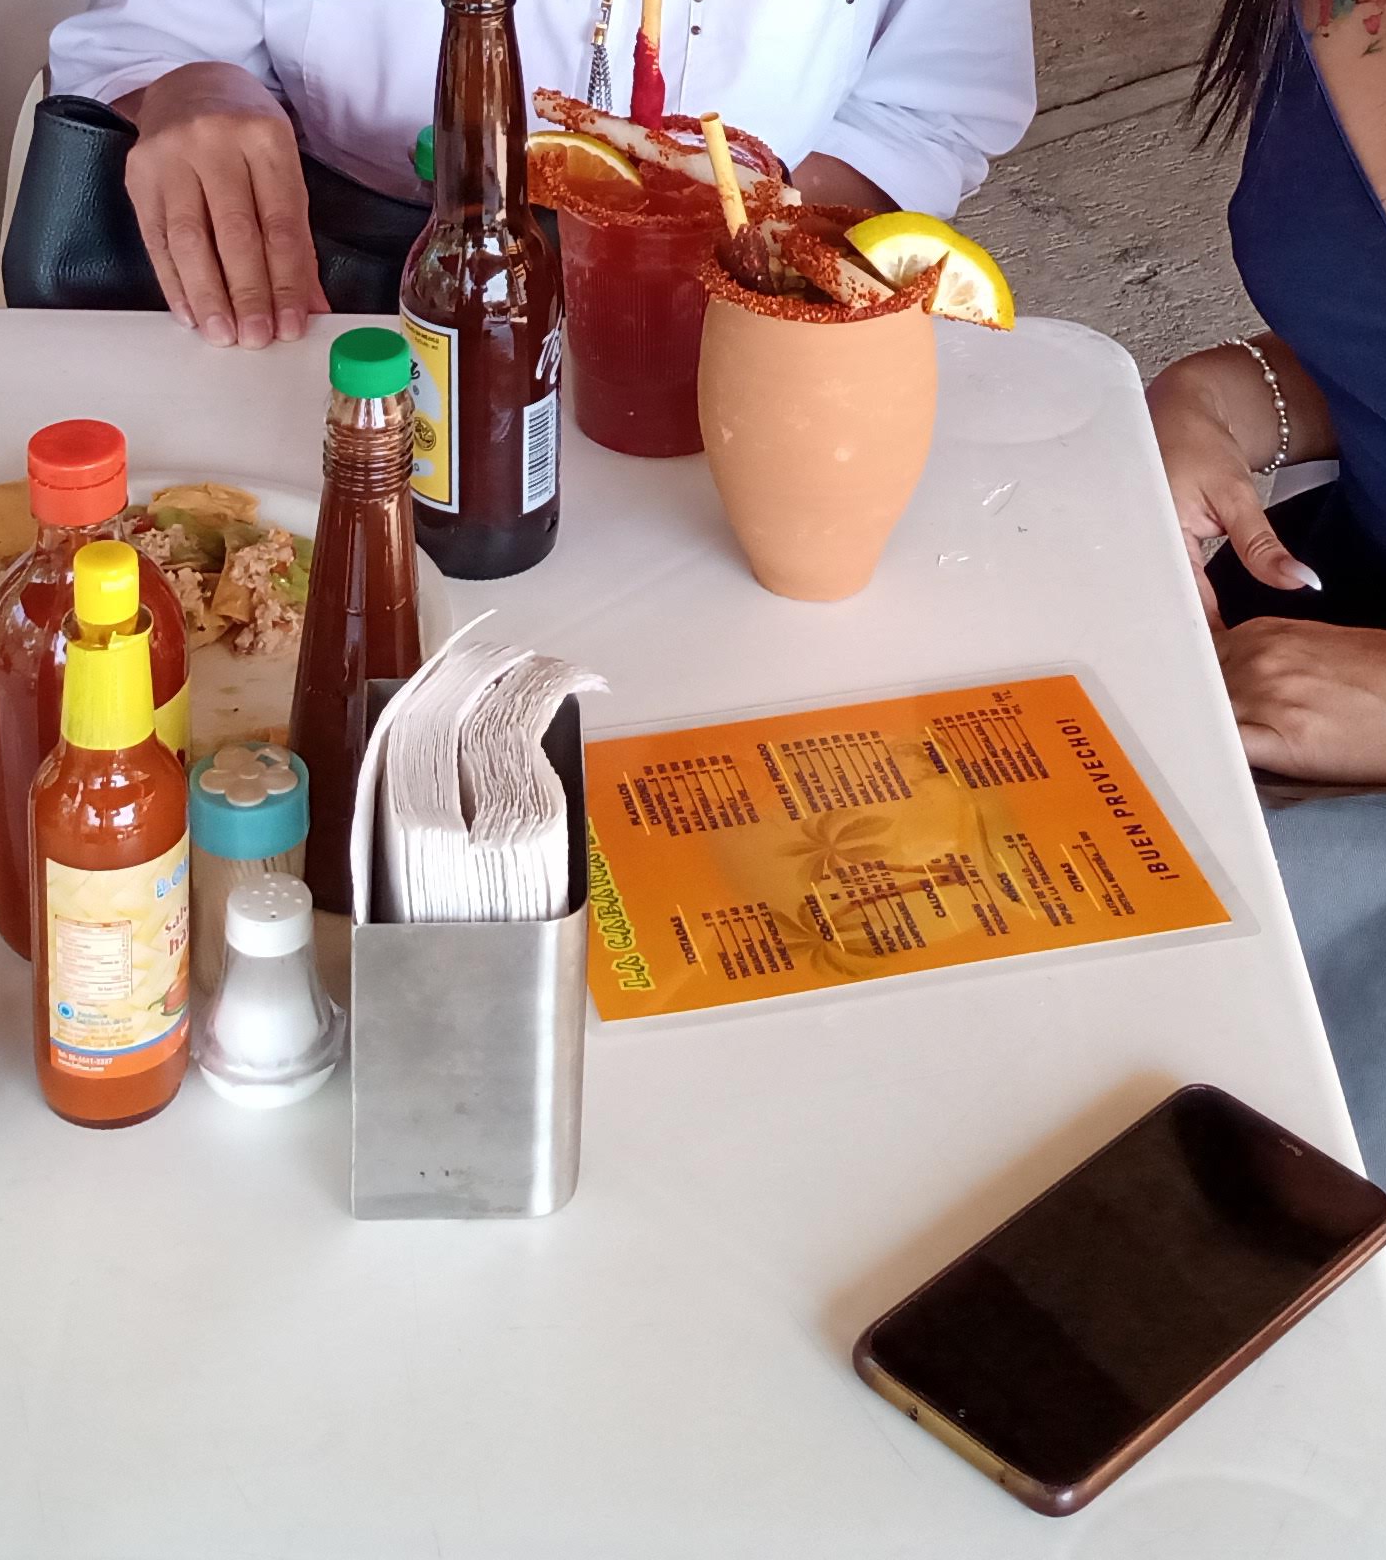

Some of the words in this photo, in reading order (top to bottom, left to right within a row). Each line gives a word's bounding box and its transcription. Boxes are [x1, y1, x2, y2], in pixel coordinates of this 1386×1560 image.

[756, 743, 782, 782] PESCADO
[1056, 719, 1134, 818] PROVECHO!
[617, 783, 642, 826] PLATILLOS
[775, 784, 788, 794] DE
[781, 796, 800, 821] FILETE
[1123, 824, 1179, 880] ¡BUEN
[1060, 862, 1084, 892] OTRAS
[804, 894, 834, 941] COCTELES
[918, 879, 946, 918] CALDOS
[670, 916, 697, 965] TOSTADAS
[614, 952, 654, 990] LA
